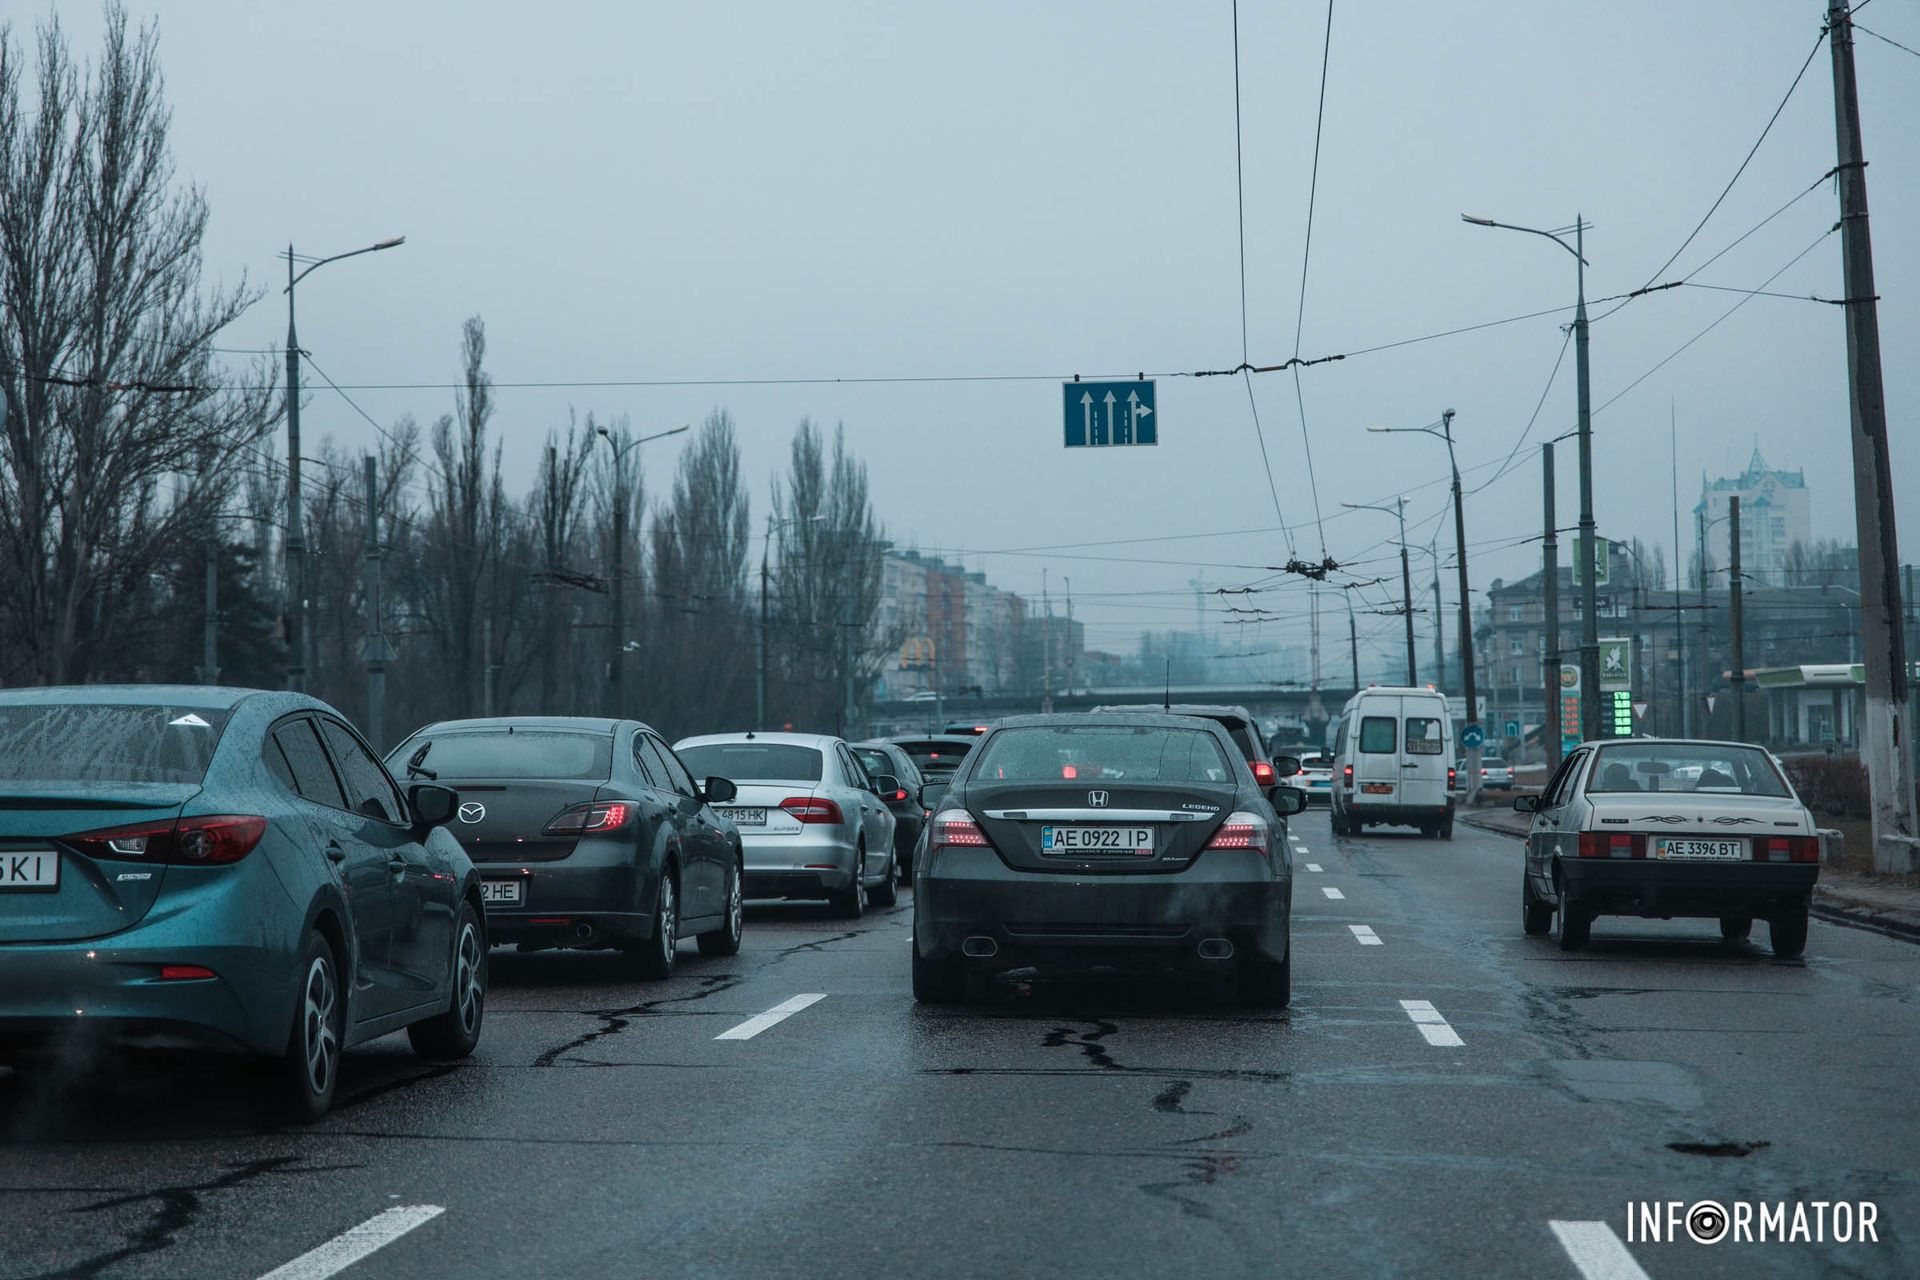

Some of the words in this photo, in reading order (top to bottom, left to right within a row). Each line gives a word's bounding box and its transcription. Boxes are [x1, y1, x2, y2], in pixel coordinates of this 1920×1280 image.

[1182, 803, 1220, 811] LEGEND
[722, 809, 746, 820] 4815
[748, 809, 764, 820] HK
[1054, 830, 1078, 847] AE
[1082, 830, 1120, 847] 0922
[1128, 830, 1149, 847] IP
[1667, 842, 1684, 855] AE
[1688, 842, 1716, 855] 3396
[1719, 843, 1737, 856] BT
[493, 884, 513, 899] HE
